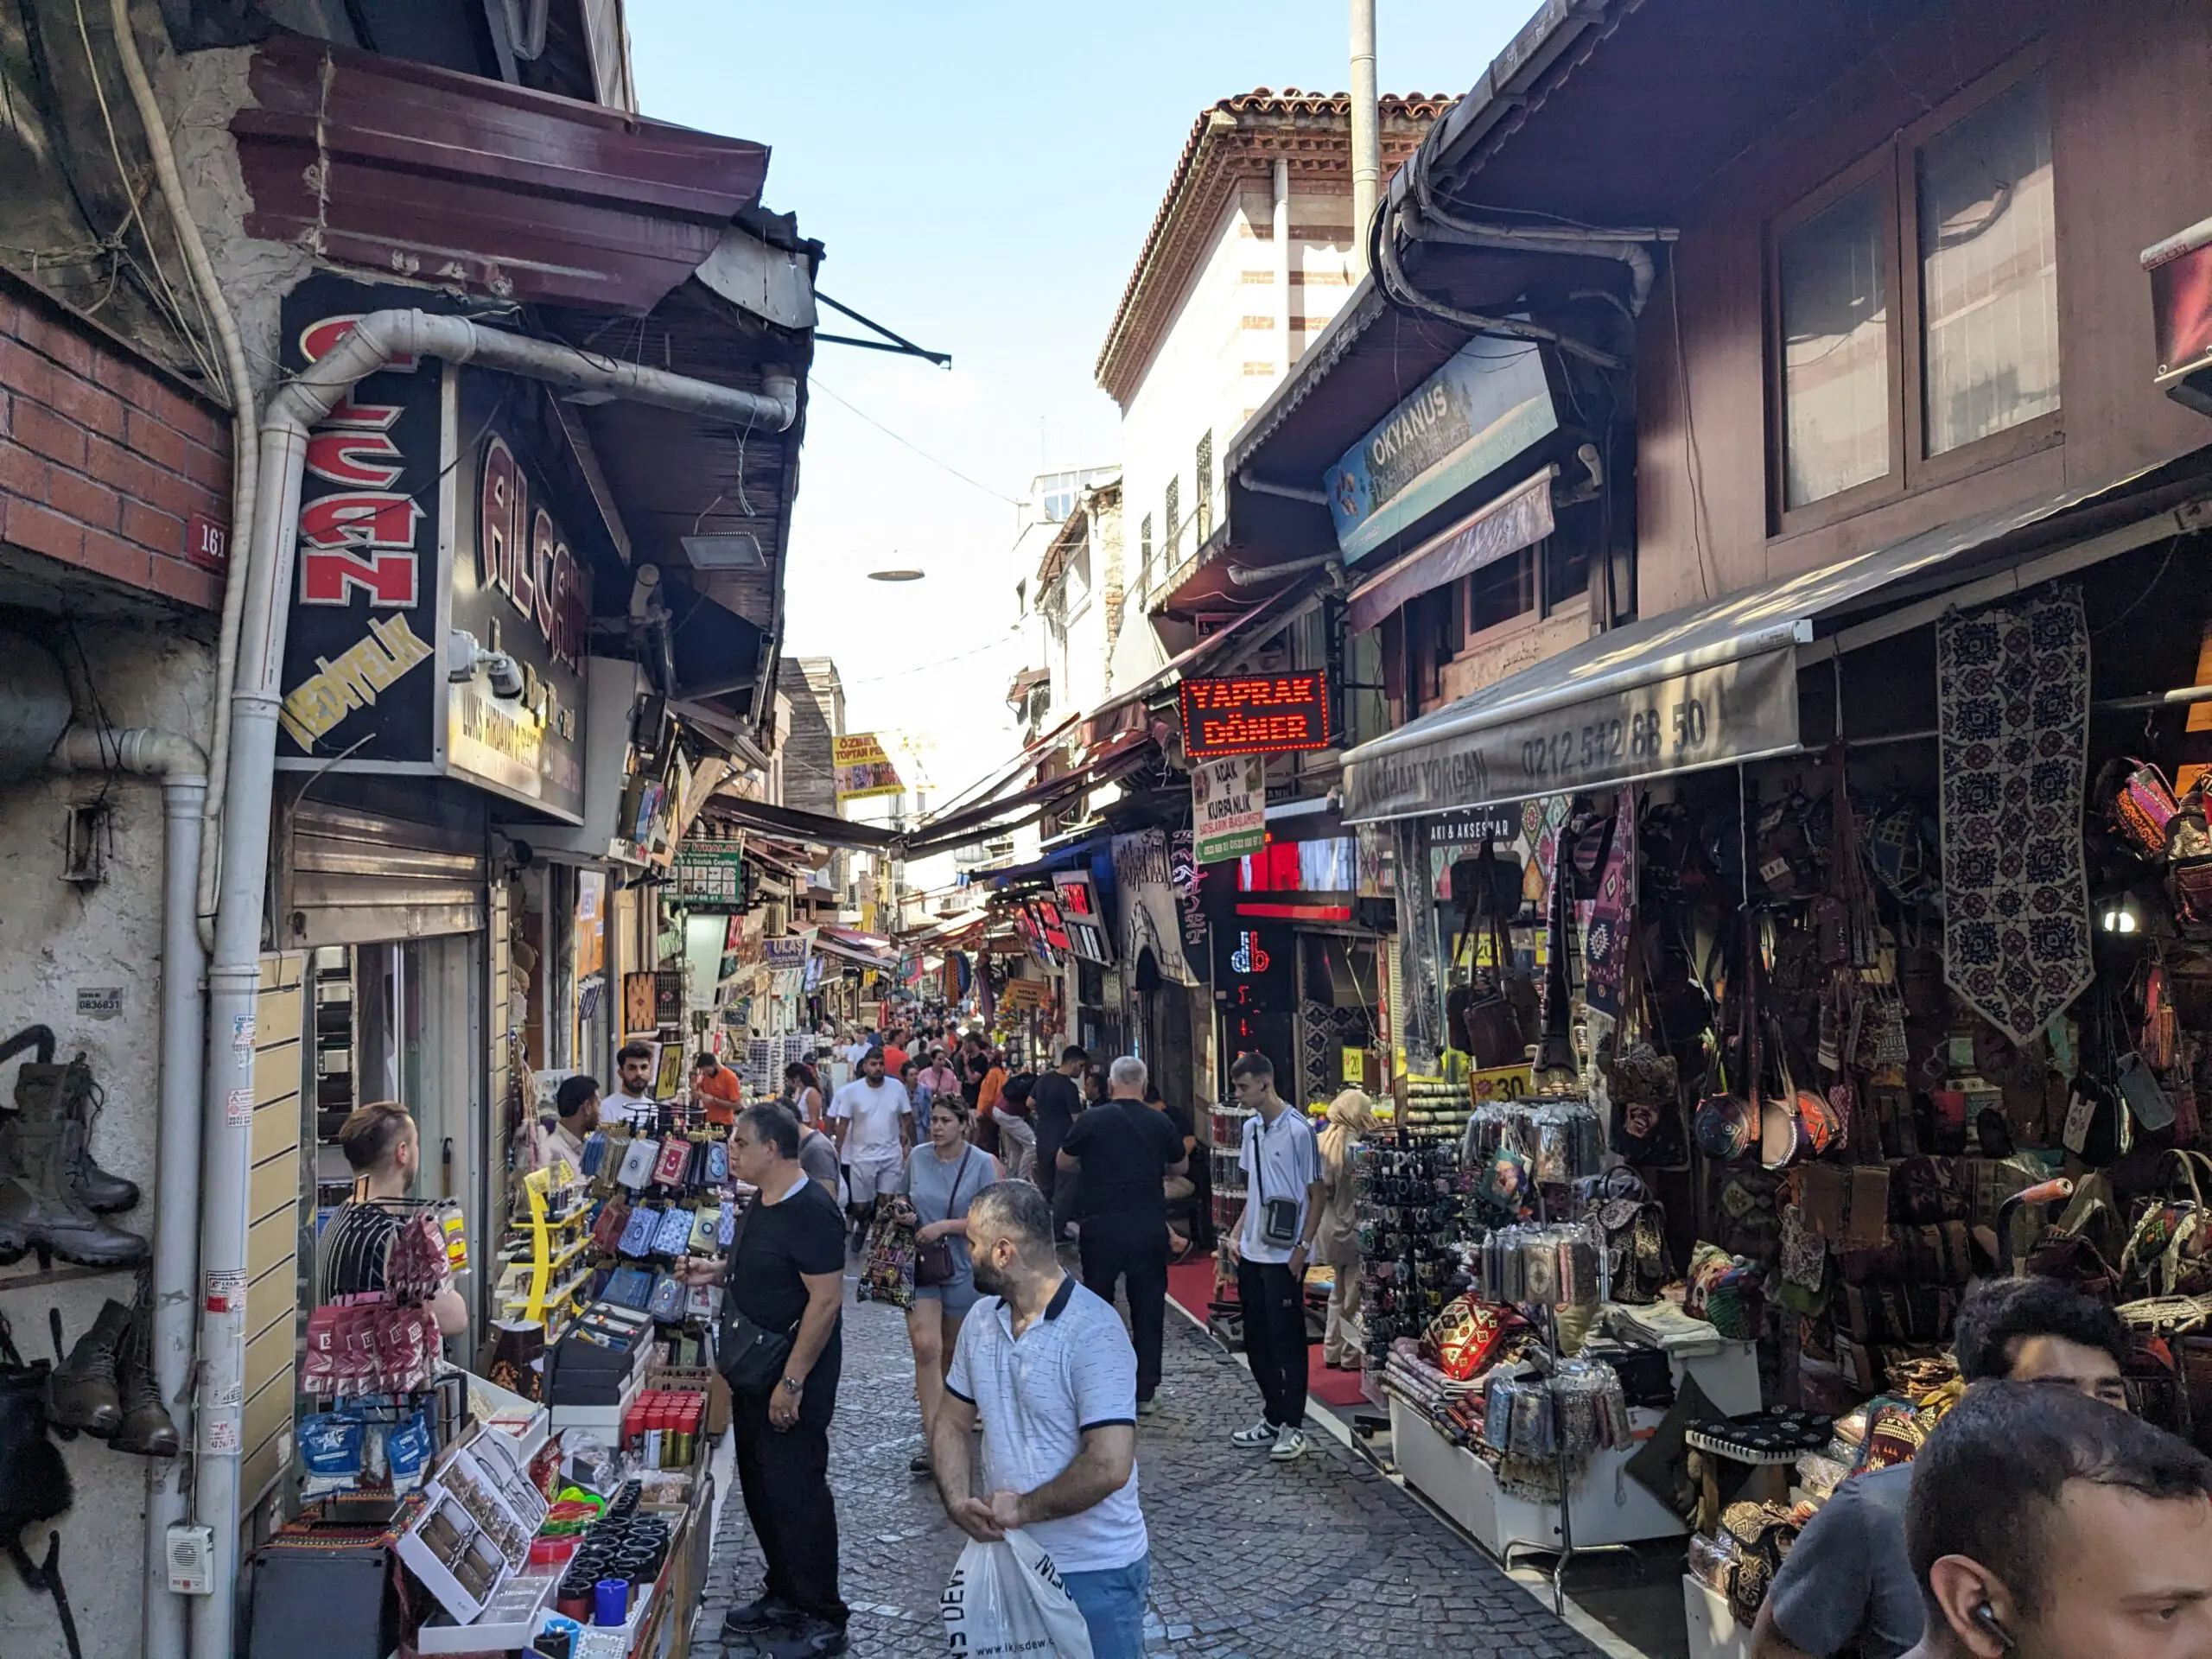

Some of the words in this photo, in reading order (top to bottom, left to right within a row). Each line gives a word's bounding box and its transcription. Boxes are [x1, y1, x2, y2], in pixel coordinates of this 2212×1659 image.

[1371, 385, 1448, 466] OKYANUS
[201, 524, 225, 557] 161
[1189, 677, 1314, 709] YAPRAK
[1203, 713, 1308, 744] DÖNER
[836, 747, 868, 760] TOPTAN
[1421, 748, 1490, 802] YORGAN
[1521, 730, 1573, 777] 0212
[1580, 718, 1623, 771] 512
[1631, 708, 1662, 757] 88
[1671, 697, 1707, 756] 50
[772, 939, 804, 956] ULAŞ
[1496, 1075, 1525, 1103] 30
